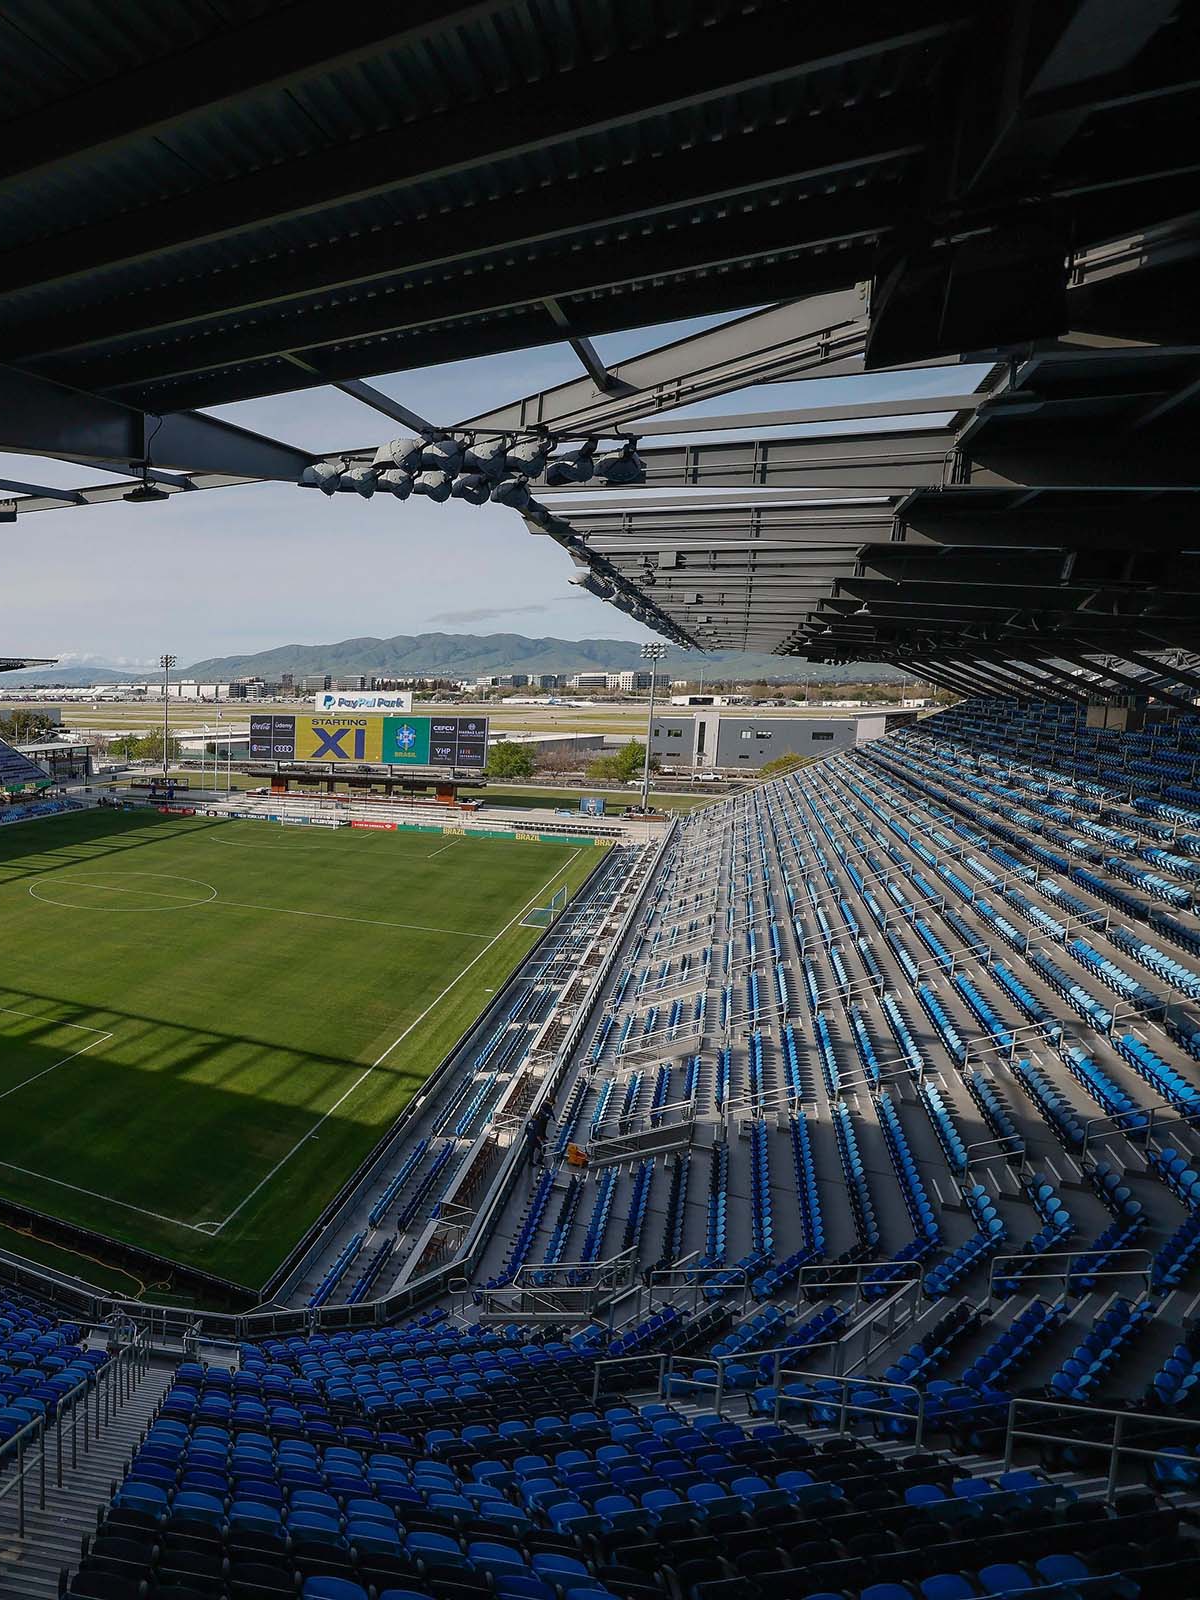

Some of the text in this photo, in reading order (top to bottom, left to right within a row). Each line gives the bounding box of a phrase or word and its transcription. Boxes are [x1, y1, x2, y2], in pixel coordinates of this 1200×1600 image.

[338, 698, 404, 709] PayPal Park
[311, 728, 365, 759] XI
[442, 827, 467, 836] BRAZIL
[515, 832, 541, 842] BRAZIL
[594, 838, 616, 846] BRAZ
